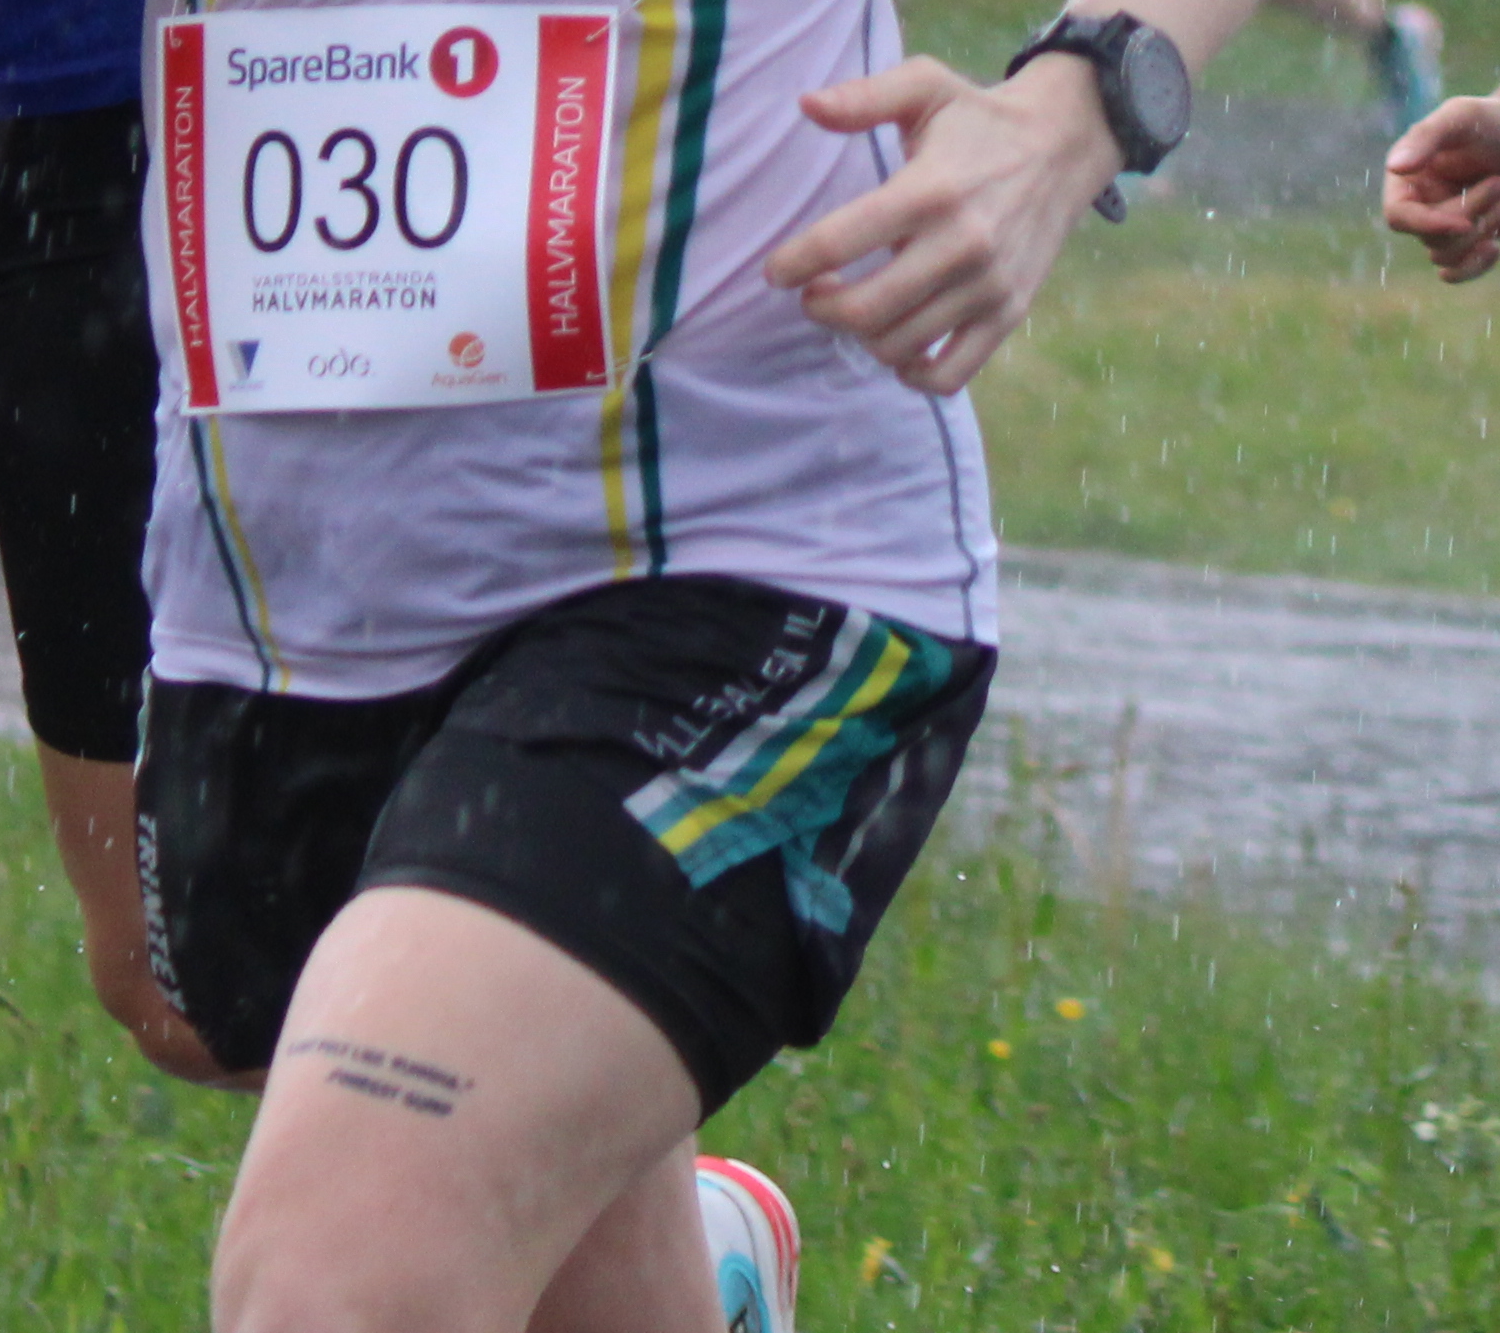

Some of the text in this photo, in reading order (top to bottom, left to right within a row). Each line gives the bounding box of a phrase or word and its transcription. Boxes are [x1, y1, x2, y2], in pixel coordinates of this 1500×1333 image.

[228, 42, 421, 91] SpareBank
[175, 86, 203, 348] HALVMARATON
[242, 124, 469, 254] 030
[546, 76, 587, 337] HALVMARATON
[252, 287, 437, 313] HALVMARATON
